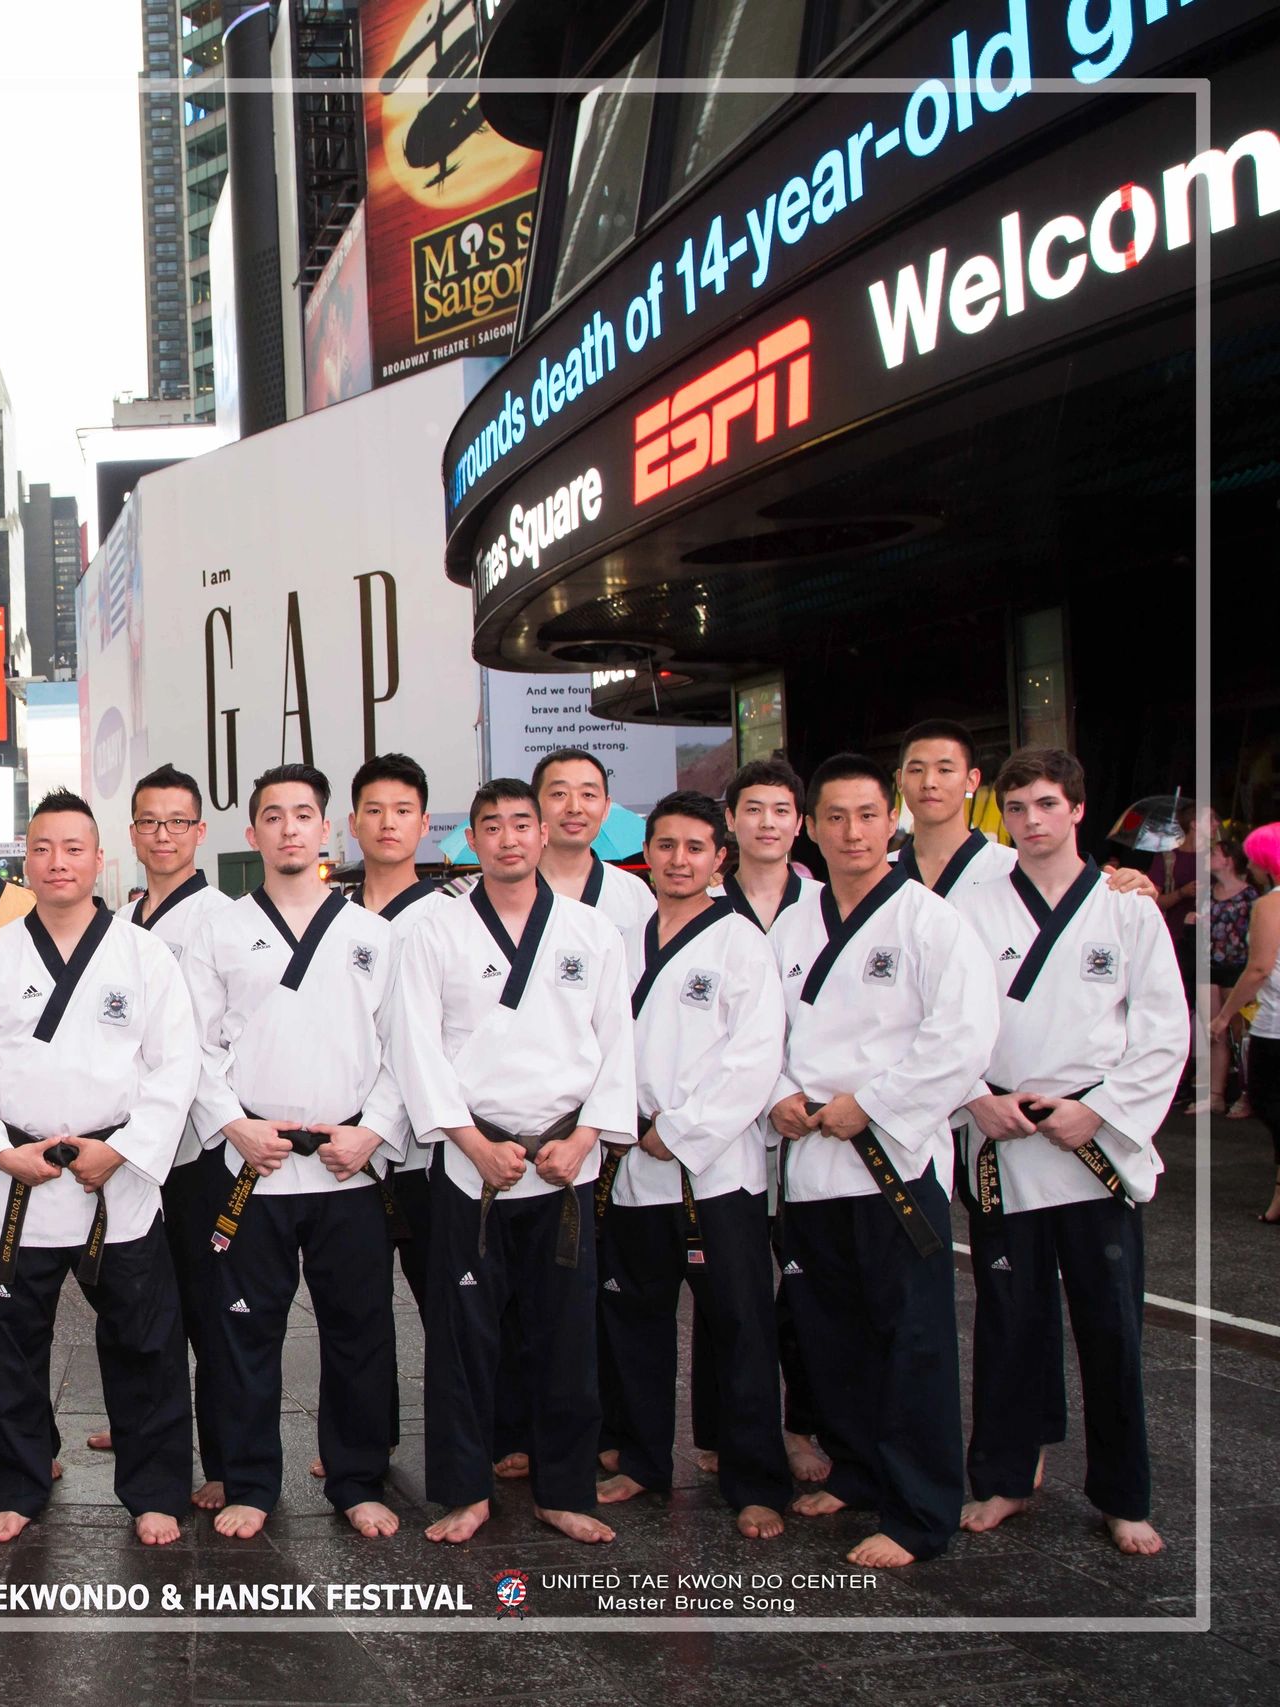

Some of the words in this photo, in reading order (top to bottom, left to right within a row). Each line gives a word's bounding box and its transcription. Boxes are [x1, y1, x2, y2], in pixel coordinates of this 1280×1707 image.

[531, 310, 616, 428] death
[625, 261, 664, 354] of
[676, 0, 1032, 315] 14-year-old
[382, 351, 429, 378] BROADWAY
[432, 337, 469, 360] THEATRE
[478, 321, 517, 345] SAIGON
[633, 314, 812, 508] ESPN
[509, 466, 603, 570] Square
[202, 570, 206, 587] I
[210, 568, 231, 585] am
[204, 570, 401, 811] GAP
[526, 686, 547, 696] And
[550, 687, 565, 695] we
[568, 685, 591, 695] foun
[531, 705, 560, 714] brave
[562, 704, 581, 713] and
[524, 724, 553, 735] funny
[556, 723, 575, 732] and
[578, 722, 627, 734] powerful,
[524, 742, 568, 753] complex
[570, 741, 589, 751] and
[592, 741, 629, 752] strong.
[428, 824, 458, 832] PENING
[9, 1198, 23, 1222] YOUN
[4, 1224, 16, 1244] WON
[2, 1244, 12, 1262] SEO
